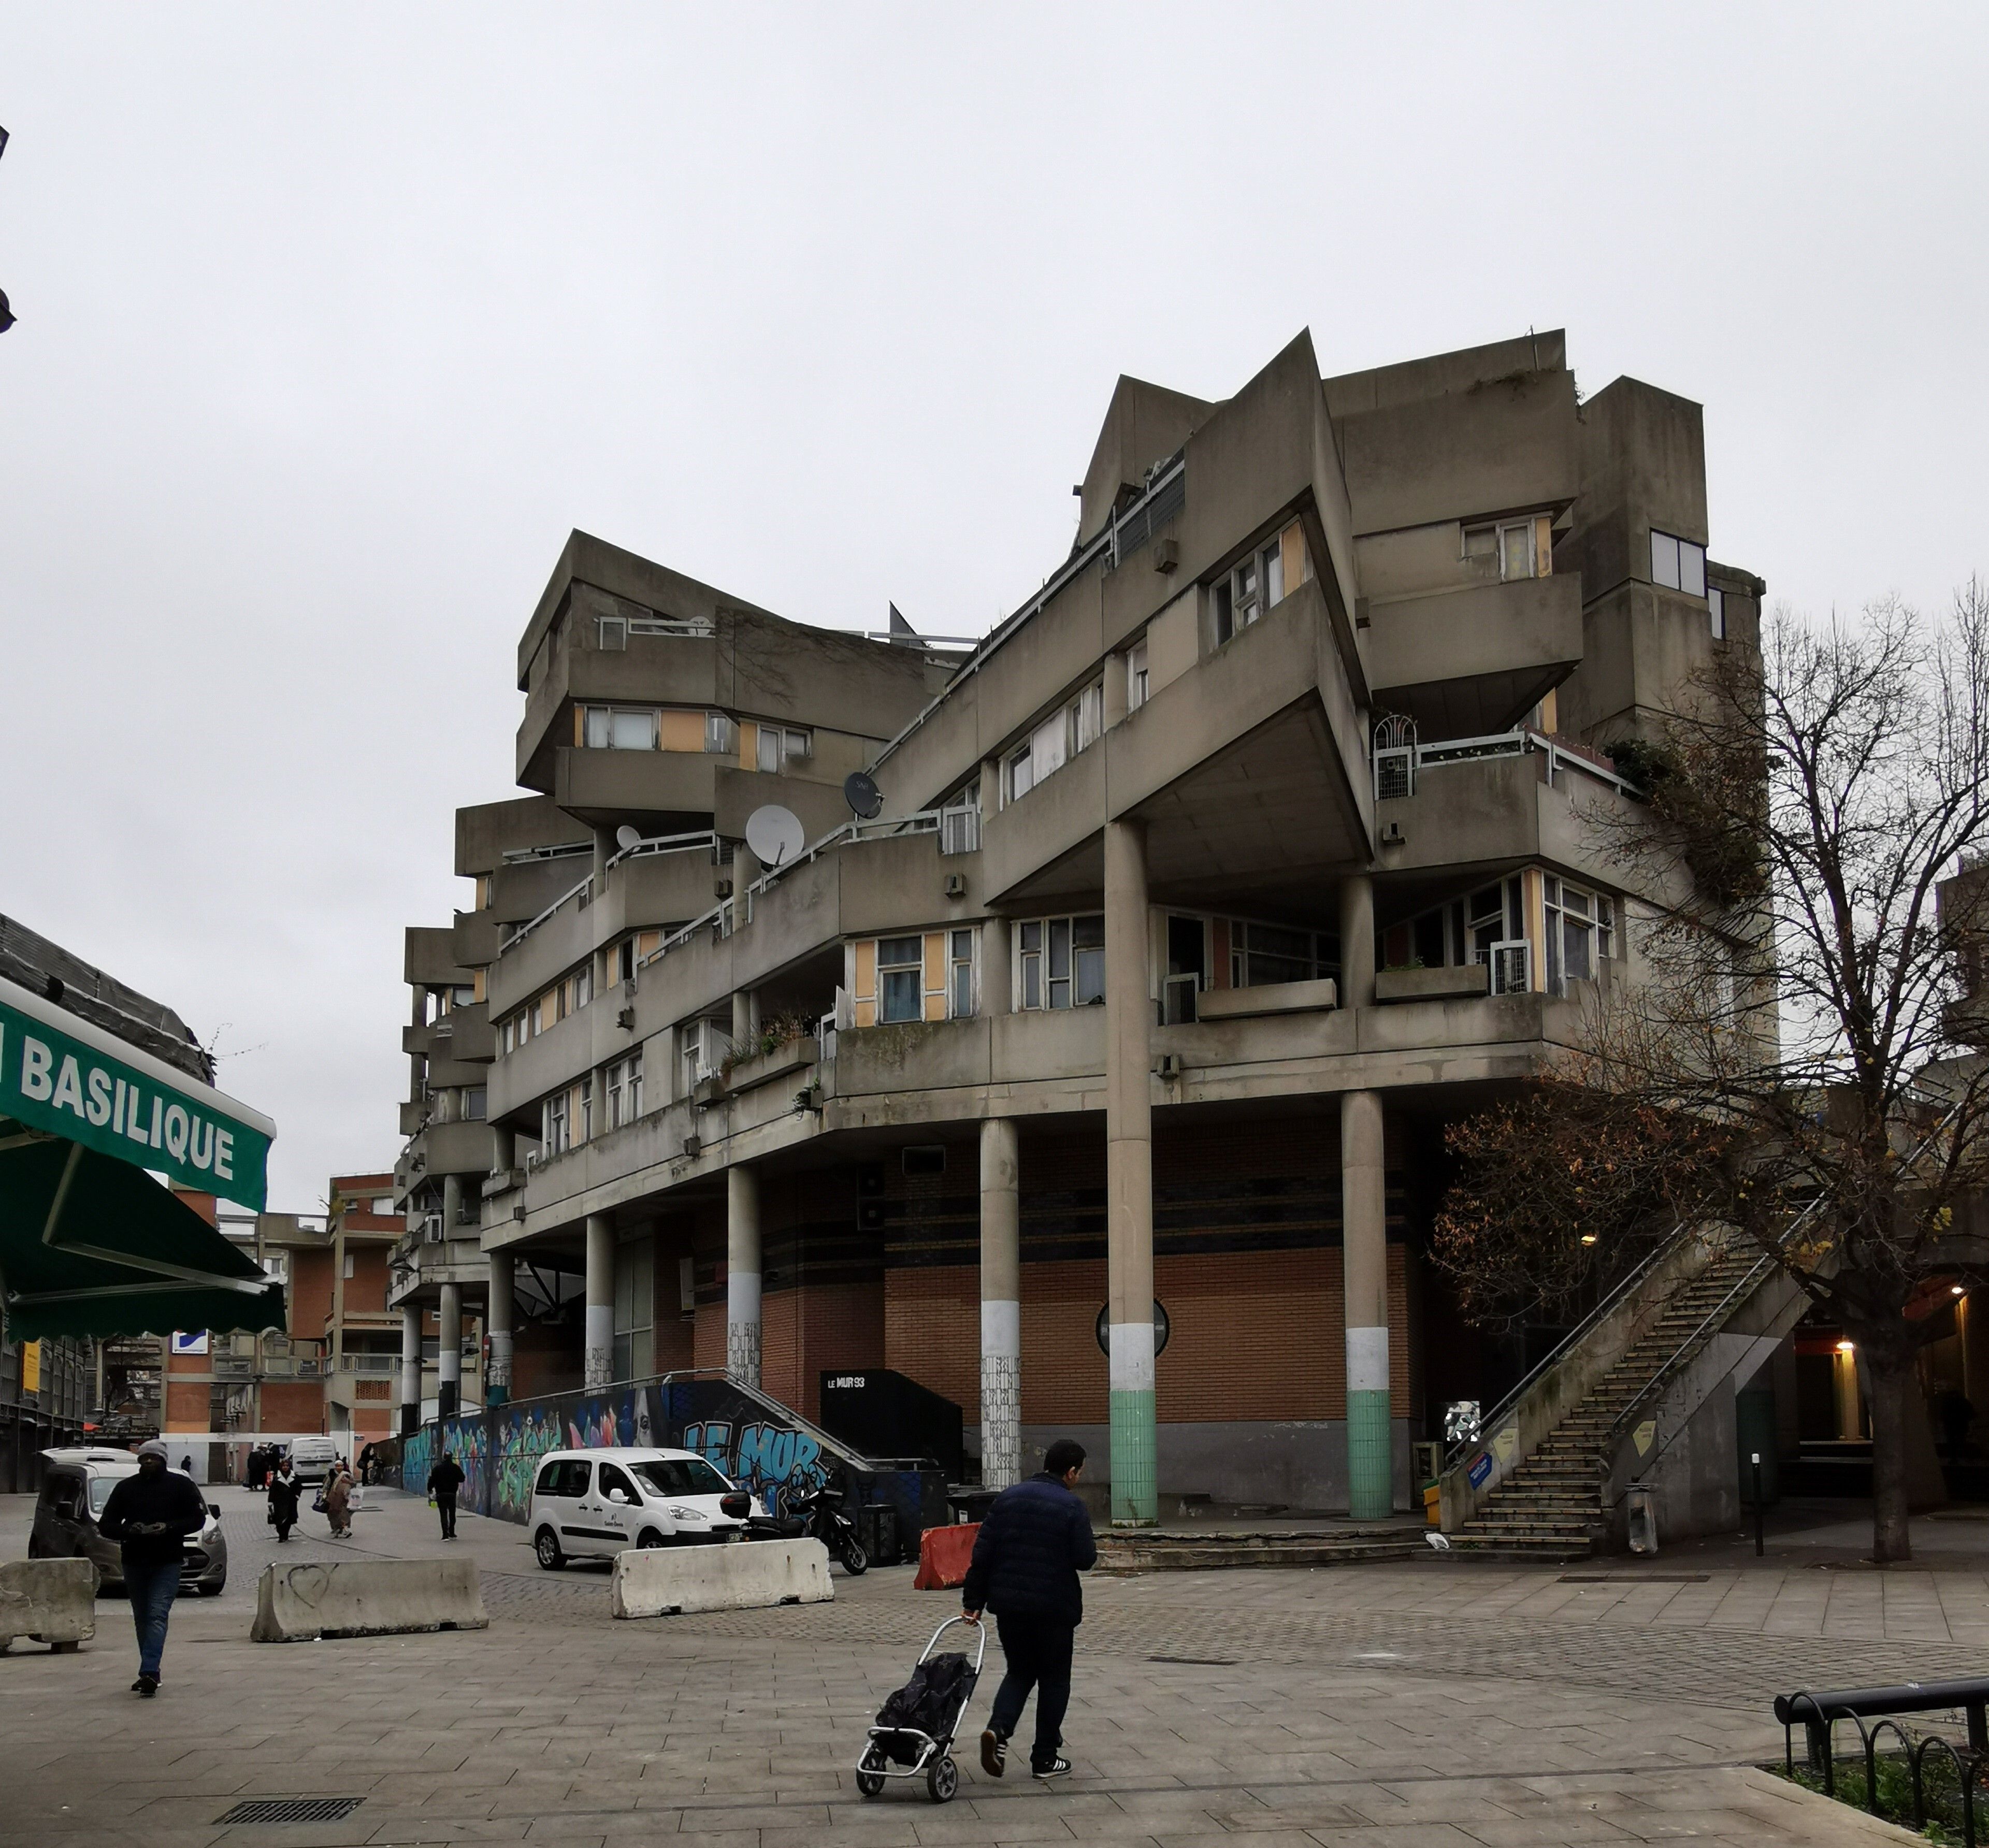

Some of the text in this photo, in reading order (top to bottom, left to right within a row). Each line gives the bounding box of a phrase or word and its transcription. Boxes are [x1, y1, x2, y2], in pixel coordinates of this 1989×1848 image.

[21, 1035, 234, 1180] BASILIQUE
[837, 1377, 854, 1388] MUR
[854, 1377, 865, 1388] 93
[684, 1421, 829, 1488] LE MUR
